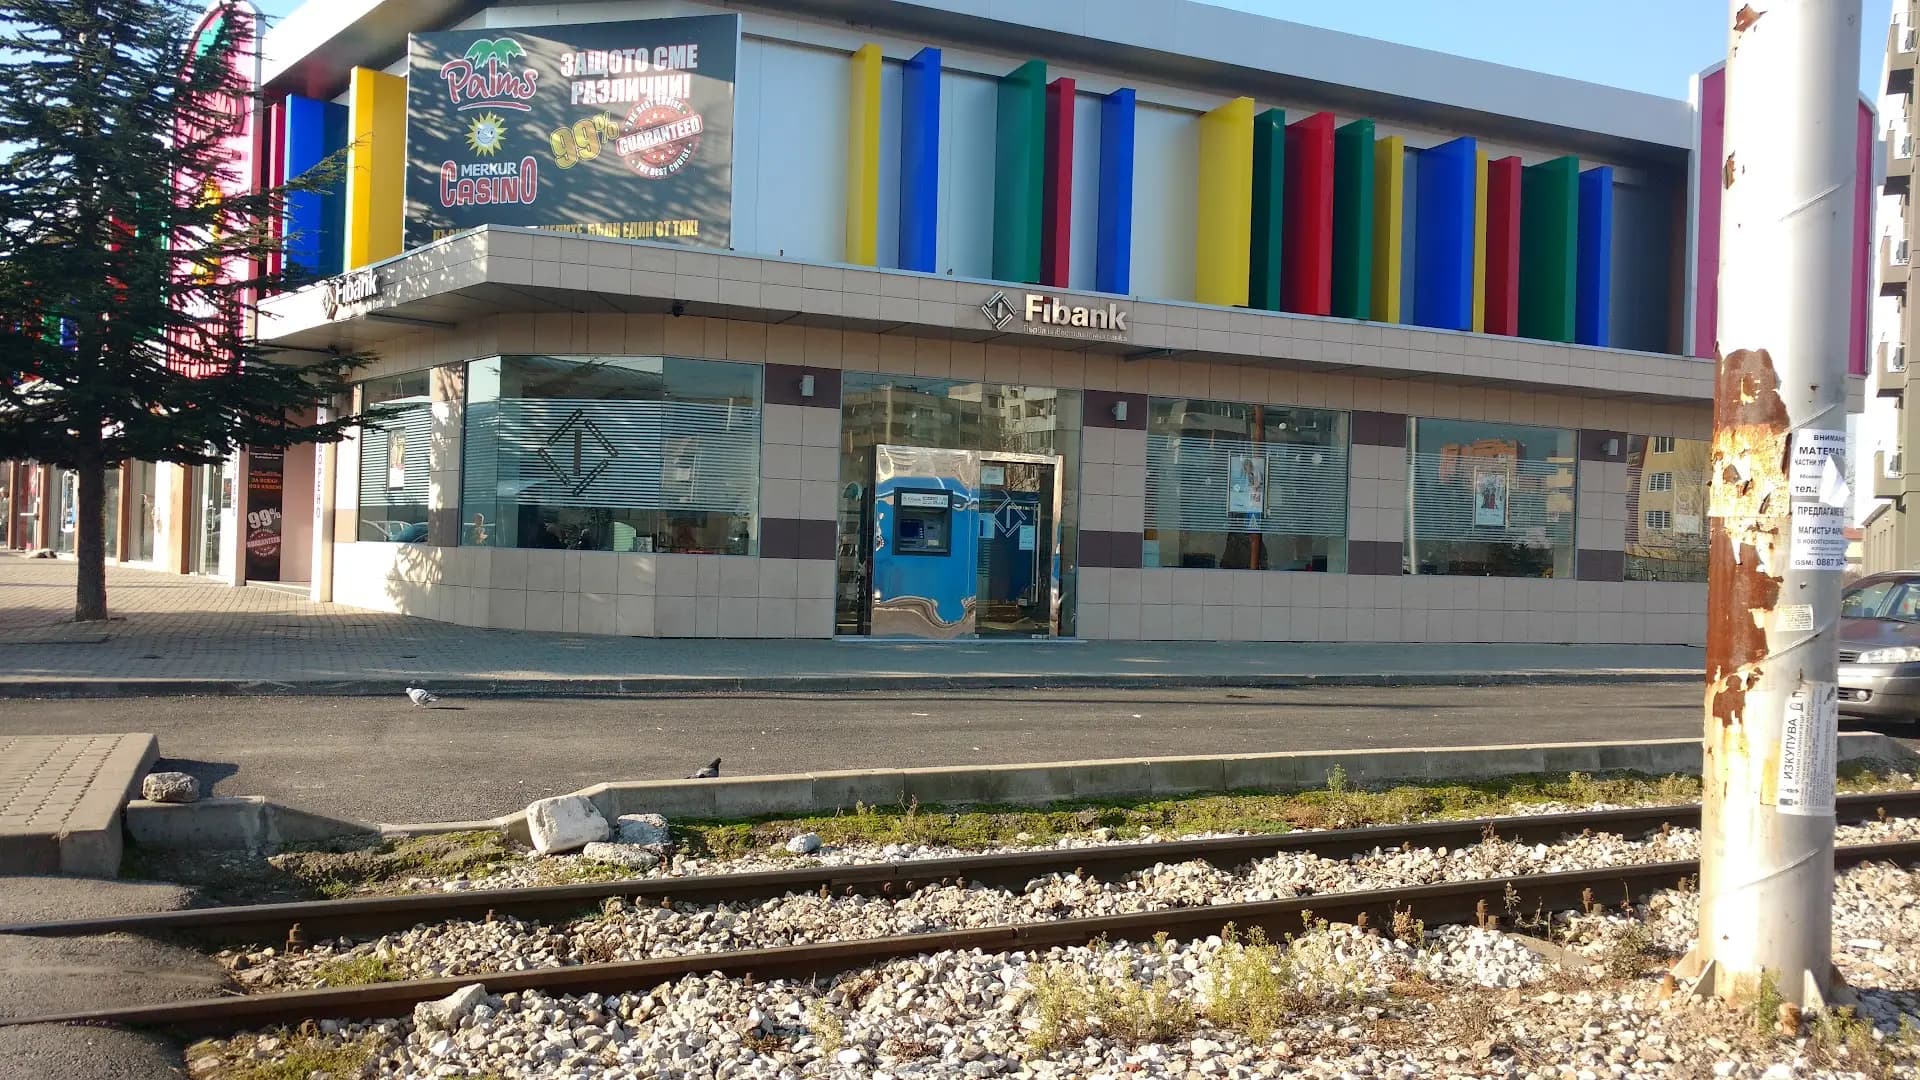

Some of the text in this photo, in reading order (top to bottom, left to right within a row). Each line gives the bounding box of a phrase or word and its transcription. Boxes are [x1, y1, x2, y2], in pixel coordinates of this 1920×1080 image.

[560, 44, 698, 77] ЗАЩОТО СМЕ
[440, 57, 538, 104] Palms
[571, 73, 691, 105] РАЗЛИЧНИ!
[550, 110, 620, 169] 99%
[618, 117, 701, 154] GUARANTEED
[440, 156, 538, 208] CASINO
[461, 161, 518, 177] MERKUR
[649, 167, 668, 177] BEST
[622, 221, 654, 240] ЕДИН
[655, 220, 671, 237] ОТ
[1025, 293, 1127, 330] Fibank
[247, 506, 281, 529] 99%
[1783, 718, 1798, 780] ИЗКУПУВА
